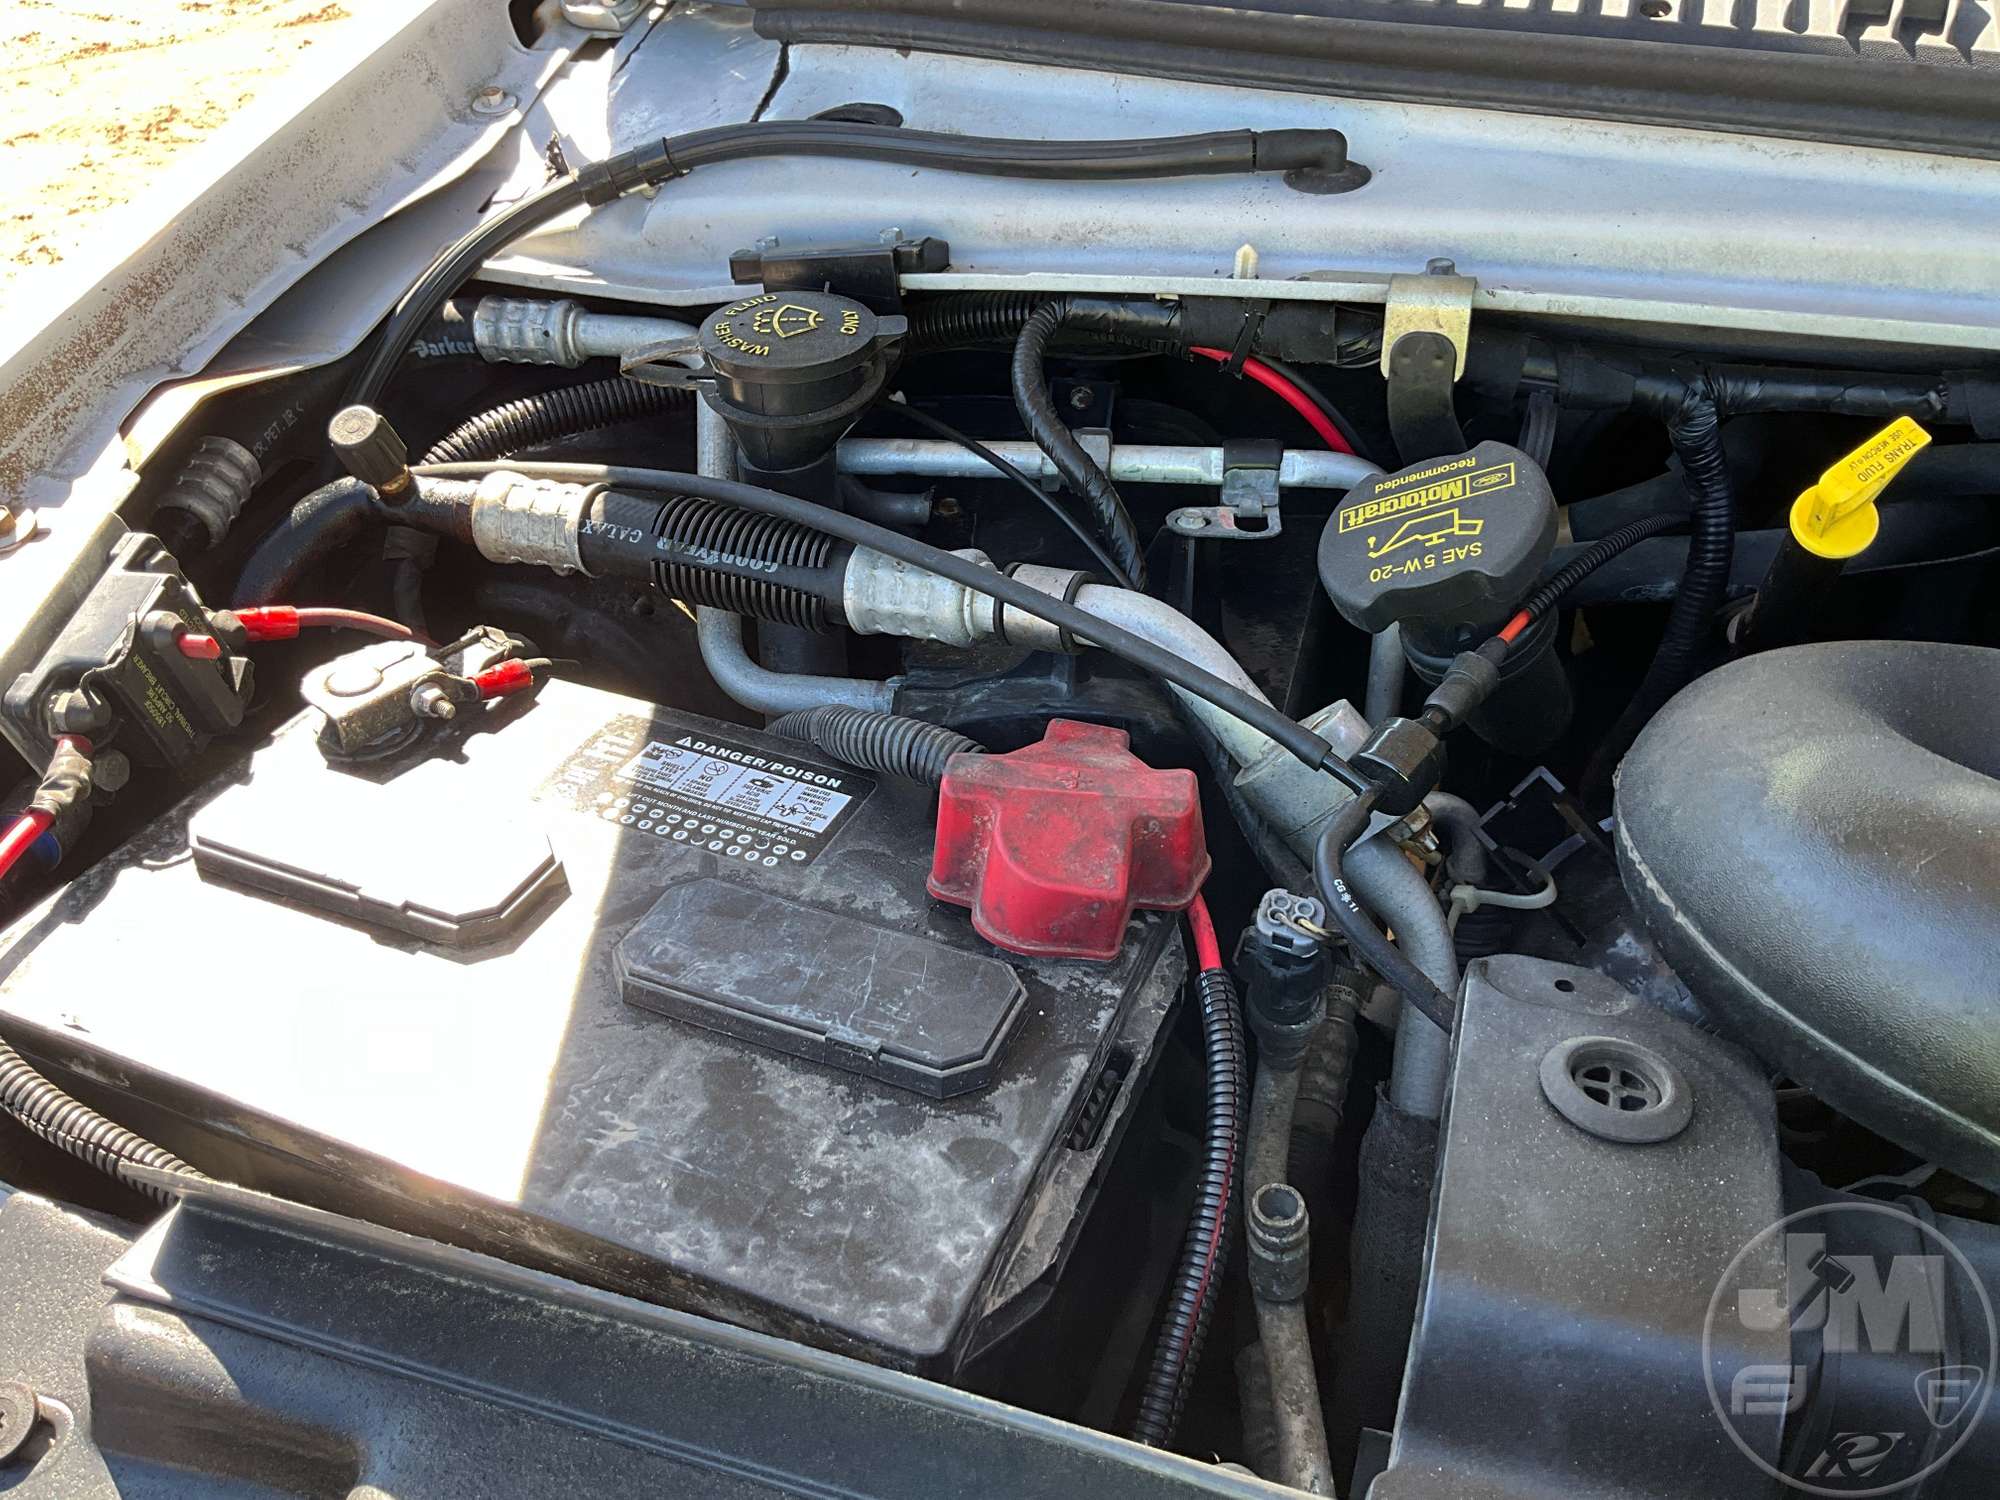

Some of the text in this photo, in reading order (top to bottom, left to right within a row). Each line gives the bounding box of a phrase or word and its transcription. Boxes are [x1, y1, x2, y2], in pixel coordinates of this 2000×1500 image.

[715, 294, 777, 356] WASHER FLUID
[840, 309, 860, 336] ONLY
[1375, 456, 1477, 494] Recommended
[1857, 438, 1917, 482] TRANS FLUID
[1345, 479, 1463, 528] Motorcraft
[1442, 541, 1482, 565] SAE
[132, 654, 157, 686] BREAKER
[692, 741, 843, 789] DANGER/POISON
[696, 773, 714, 782] NO
[639, 795, 658, 804] OUT
[654, 800, 684, 811] MONTH
[680, 807, 699, 816] AND
[695, 811, 716, 821] LAST
[713, 817, 747, 830] NUMBER
[743, 825, 756, 833] OF
[755, 829, 777, 839] YEAR
